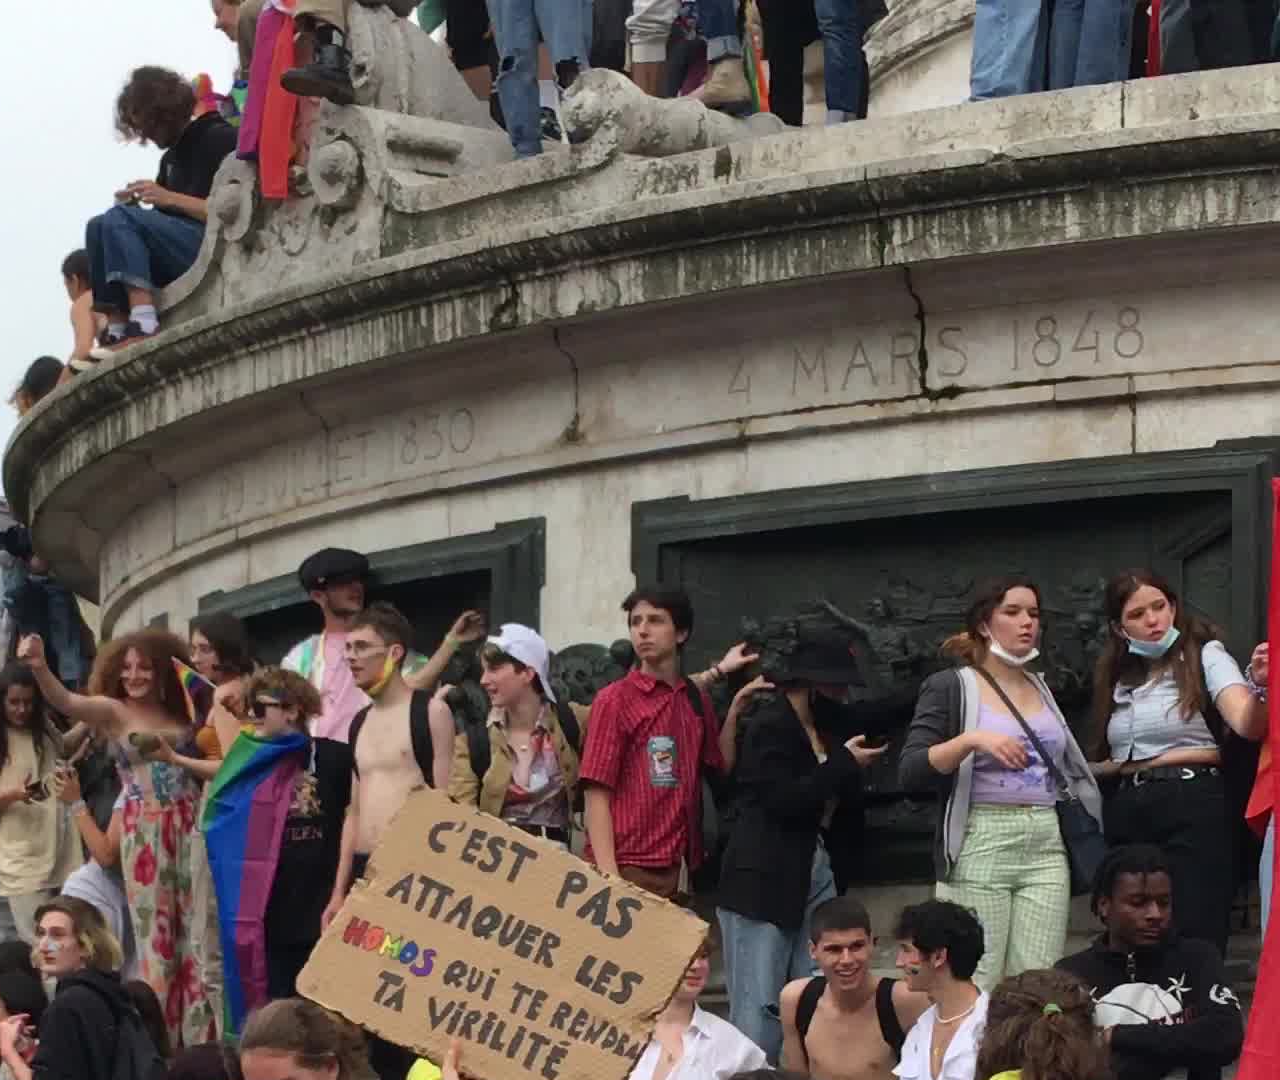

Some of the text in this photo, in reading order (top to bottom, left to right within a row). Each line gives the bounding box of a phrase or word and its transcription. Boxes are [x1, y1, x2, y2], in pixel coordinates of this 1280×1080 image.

[727, 306, 1145, 405] 4 MARS 1848
[390, 407, 475, 470] 1830
[428, 821, 643, 939] C'EST PAS
[342, 915, 436, 977] HOMOS
[508, 981, 550, 1022] TE
[385, 872, 645, 1005] ATTAQUER LES
[373, 969, 407, 1013] TA
